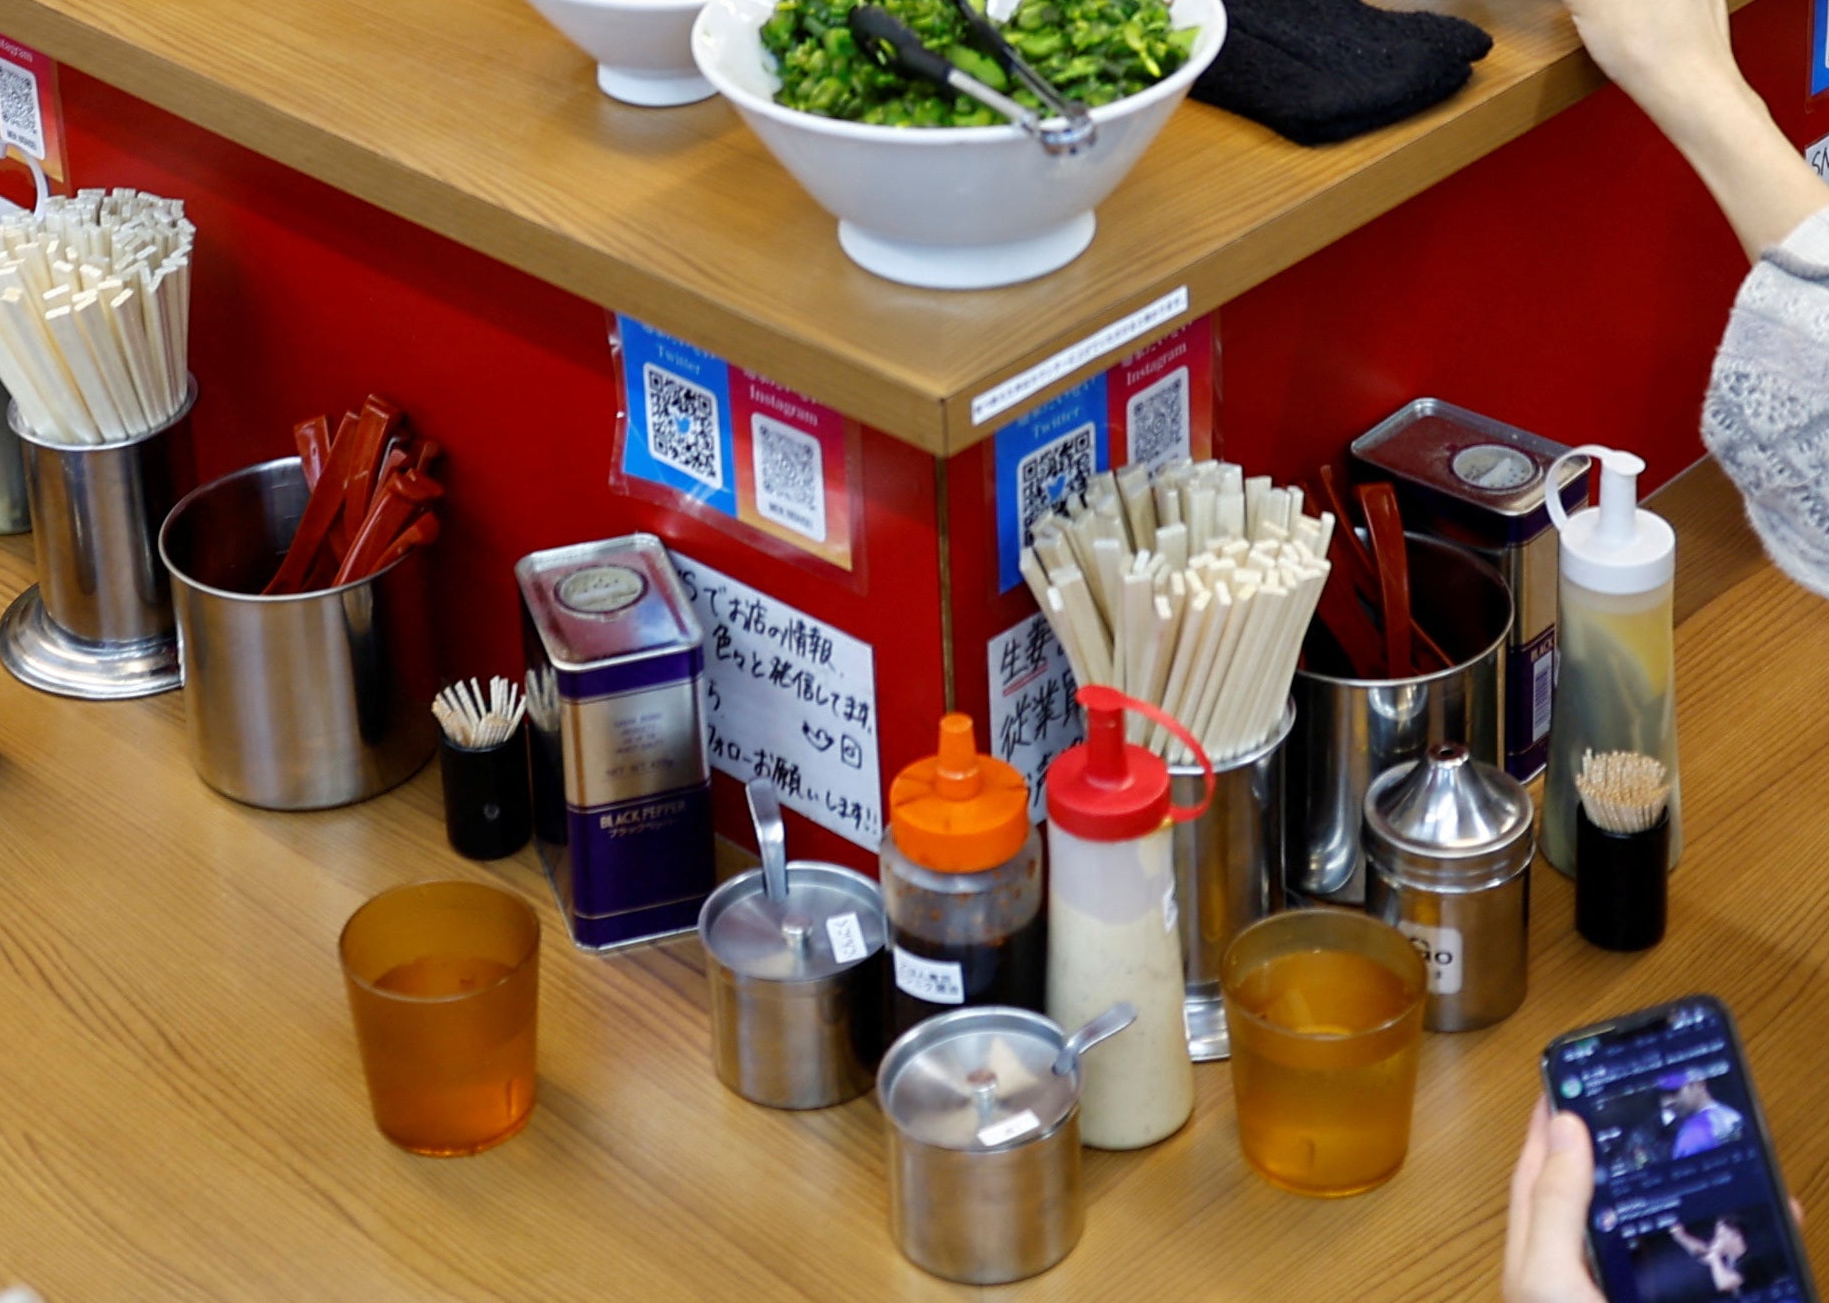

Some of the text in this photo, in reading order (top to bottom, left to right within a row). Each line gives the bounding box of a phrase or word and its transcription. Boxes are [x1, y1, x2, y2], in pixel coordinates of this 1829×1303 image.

[656, 340, 701, 376] Twitter
[1126, 342, 1188, 387] Instagram
[749, 383, 819, 427] Instagram
